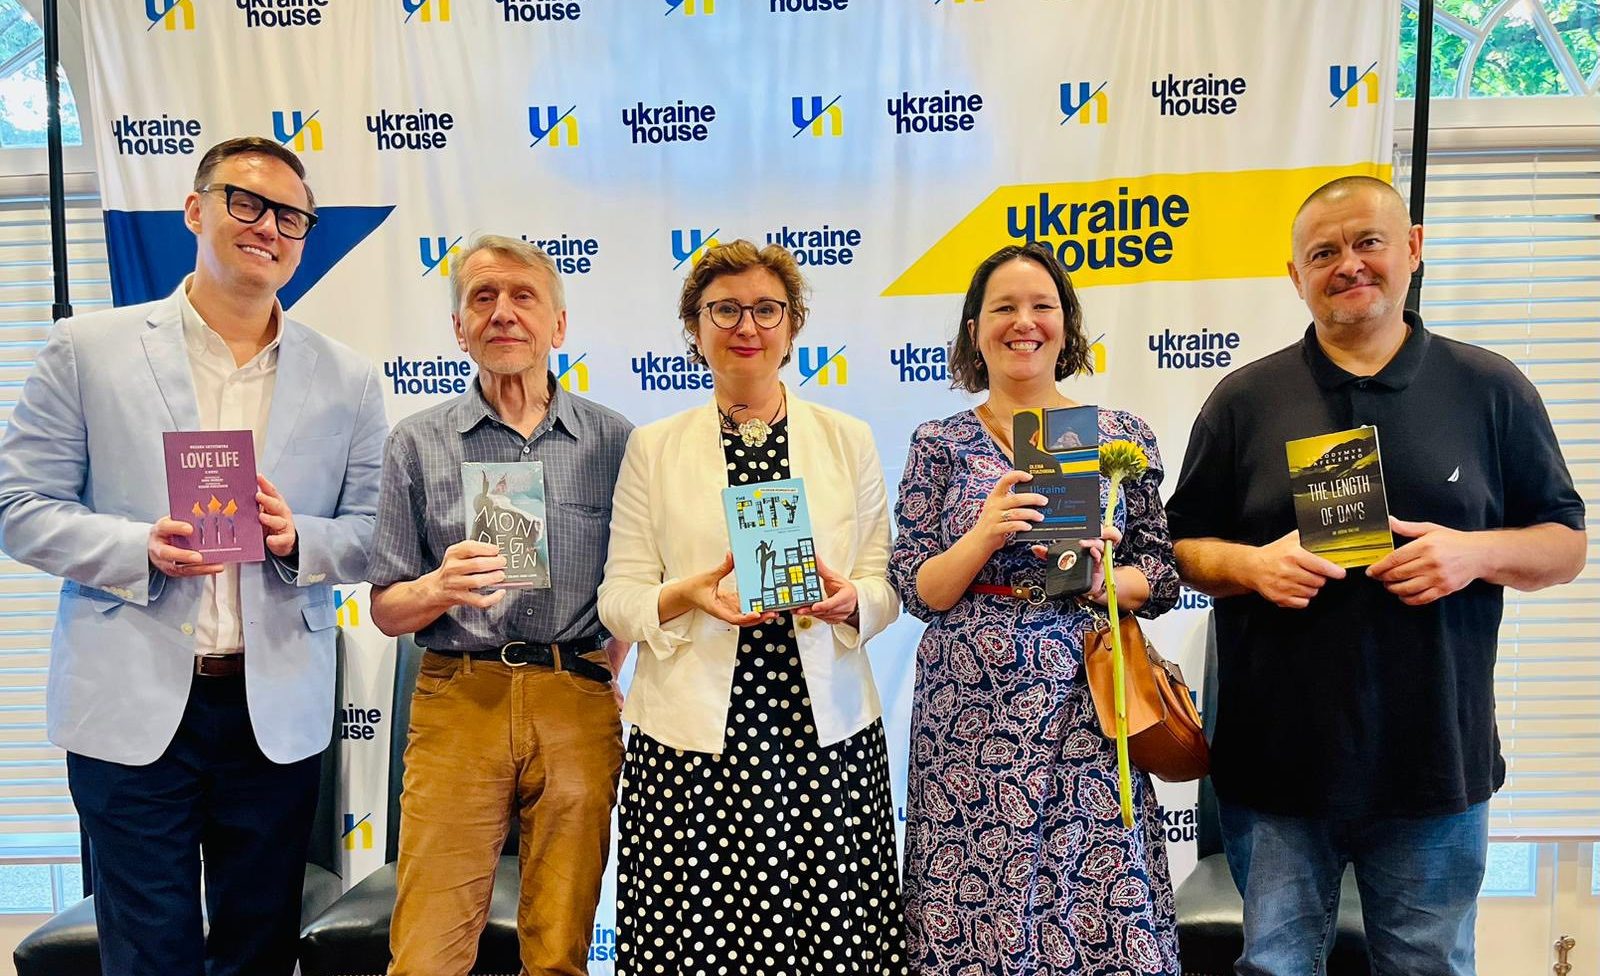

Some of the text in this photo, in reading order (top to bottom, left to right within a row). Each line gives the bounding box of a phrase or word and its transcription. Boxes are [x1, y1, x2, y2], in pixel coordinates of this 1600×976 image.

[247, 8, 322, 28] house
[505, 2, 581, 22] house
[770, 0, 849, 13] house
[1151, 73, 1246, 97] ukraine
[622, 100, 716, 125] ukraine
[888, 90, 983, 115] ukraine
[1161, 93, 1237, 116] house
[111, 114, 202, 138] ukraine
[366, 108, 454, 132] ukraine
[897, 111, 975, 135] house
[376, 129, 447, 151] house
[631, 121, 708, 144] house
[118, 134, 195, 156] house
[1007, 186, 1190, 240] ukraine
[522, 234, 599, 256] raine
[793, 247, 854, 267] ouse
[1149, 328, 1240, 351] ukraine
[384, 355, 472, 379] ukraine
[1158, 349, 1232, 369] house
[393, 374, 467, 395] house
[641, 371, 714, 391] house
[181, 451, 240, 469] LOVE LIFE
[1307, 474, 1371, 502] THE LENGTH
[475, 505, 534, 538] MON
[736, 494, 799, 529] CITY
[1320, 501, 1366, 526] OF DAYS
